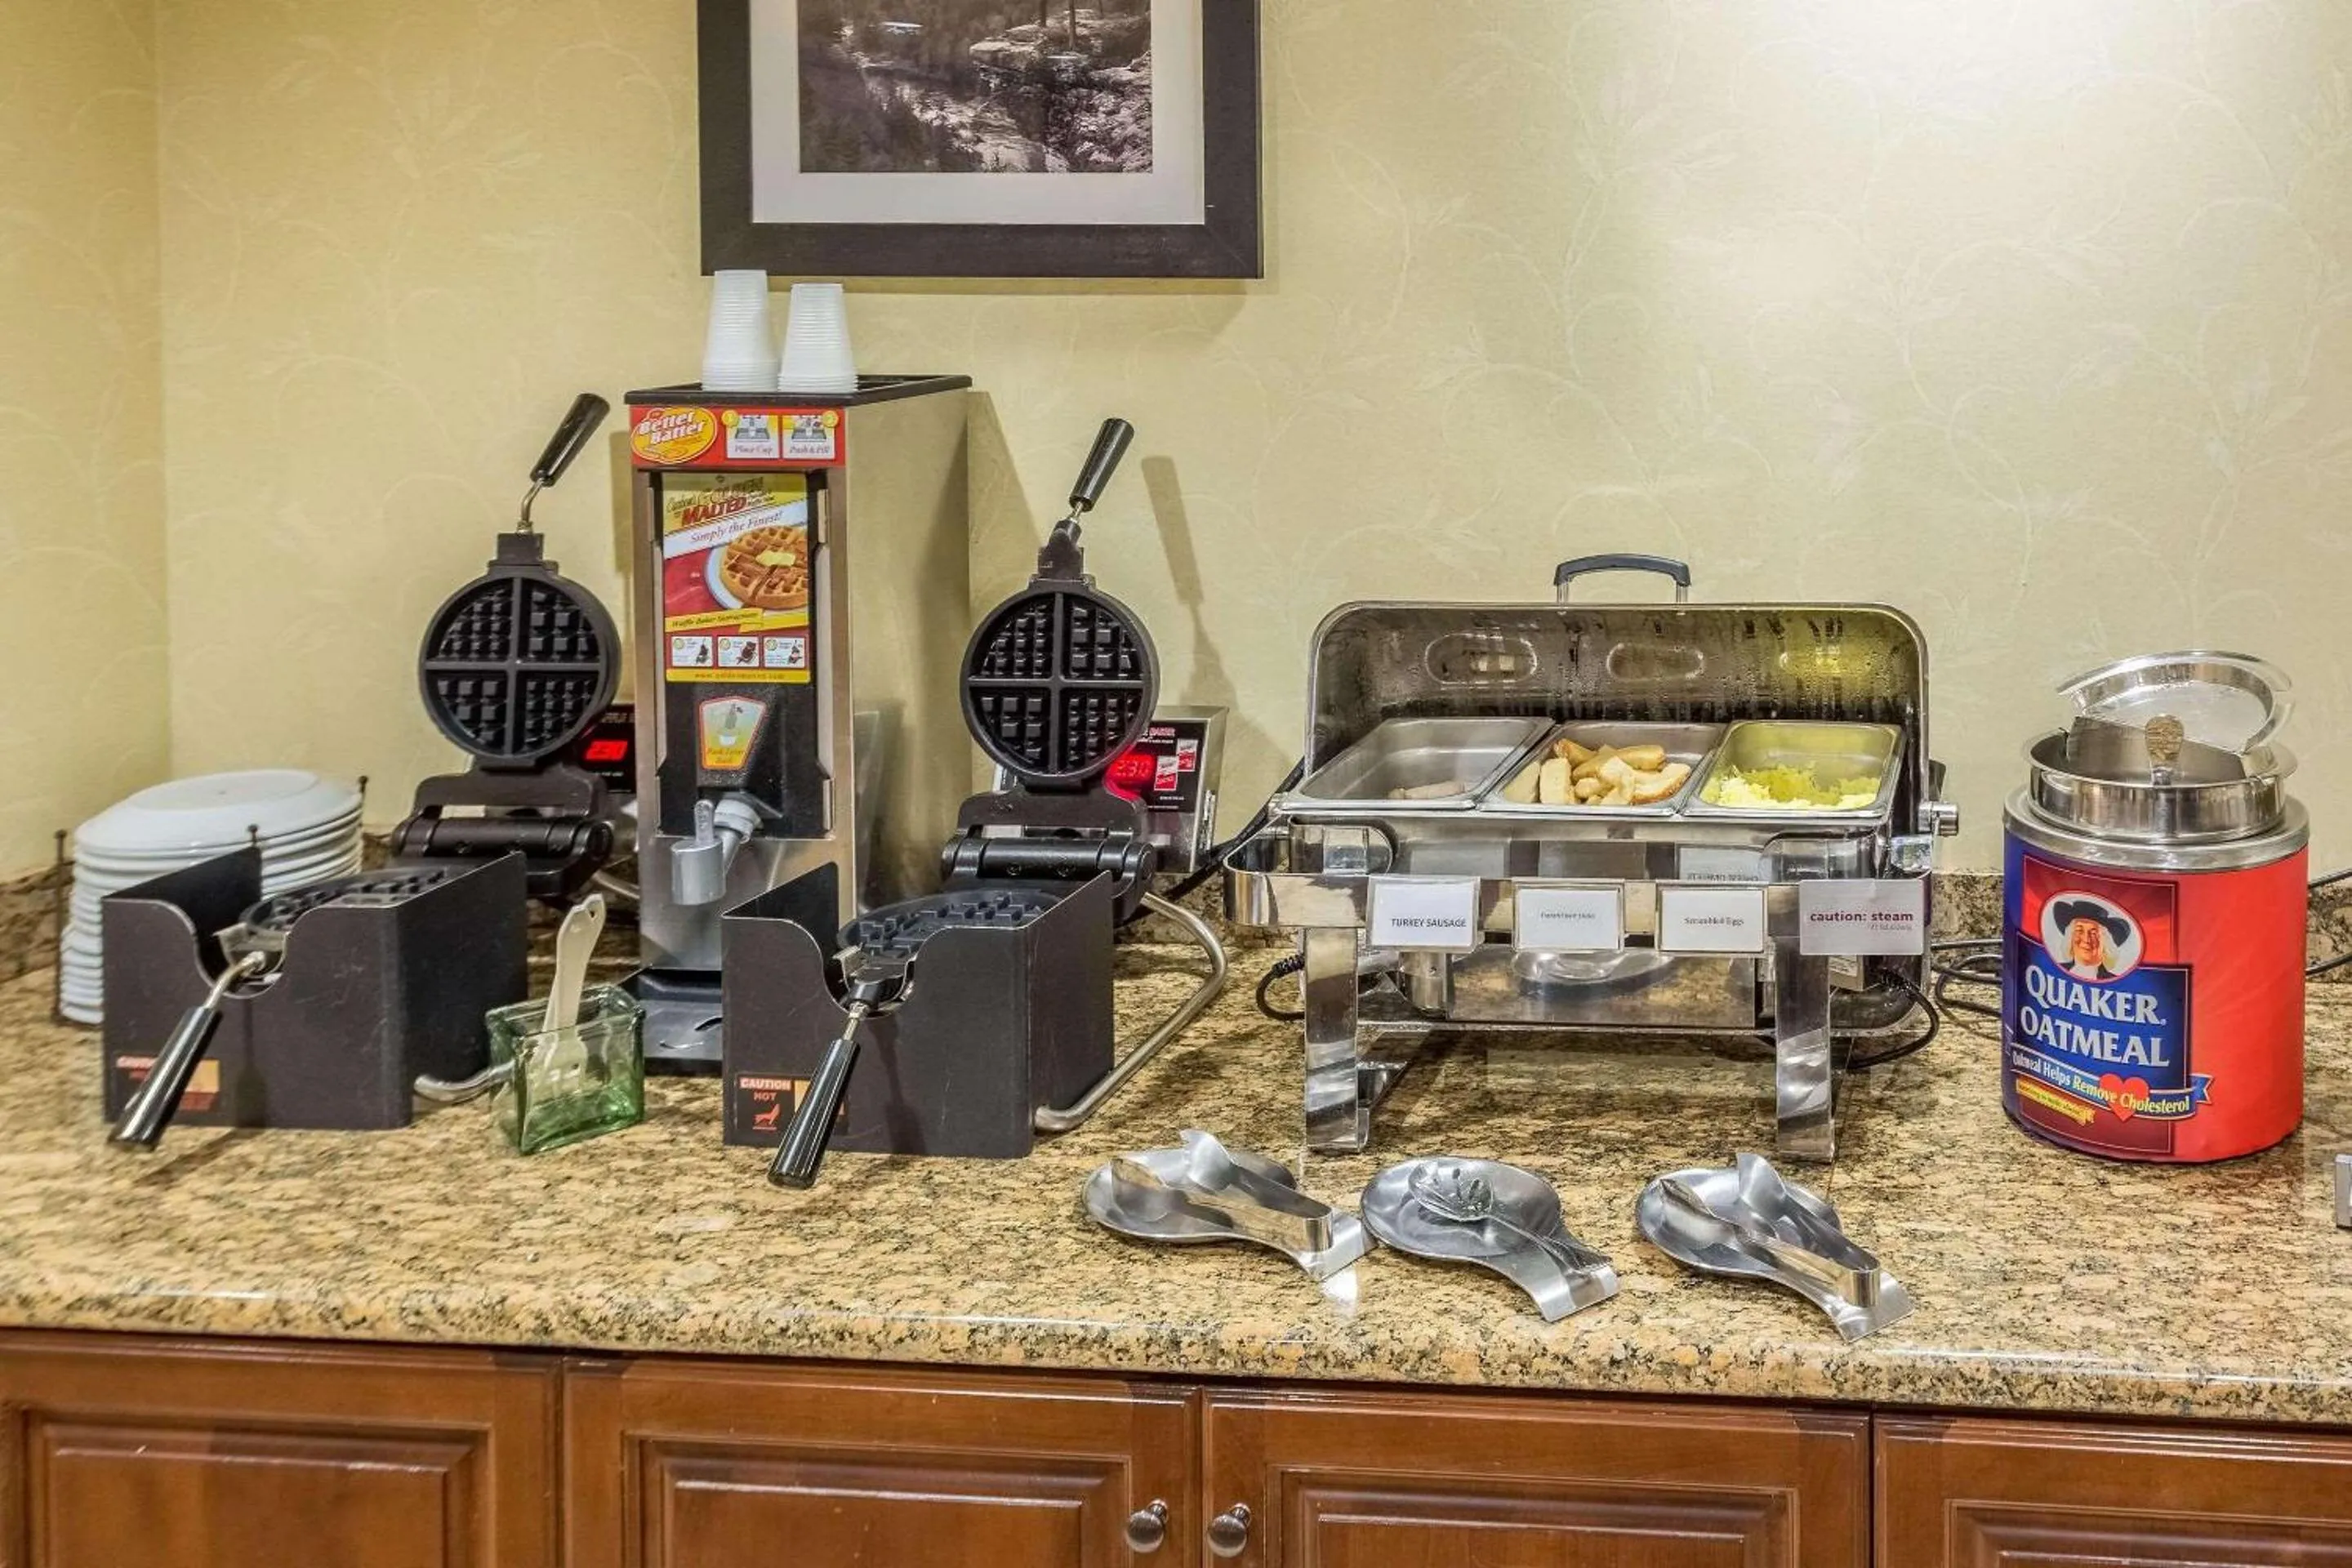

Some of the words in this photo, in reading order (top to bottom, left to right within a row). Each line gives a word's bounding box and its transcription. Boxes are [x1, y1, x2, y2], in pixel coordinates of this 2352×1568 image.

[681, 497, 747, 527] MALTED
[690, 525, 724, 543] Simply
[728, 521, 746, 535] the
[1391, 917, 1424, 929] TURKEY
[1425, 917, 1468, 929] SAUSAGE
[1810, 911, 1868, 922] caution:
[1870, 911, 1913, 922] steam
[2025, 964, 2159, 1025] QUAKER
[2020, 1005, 2170, 1067] OATMEAL
[739, 1077, 791, 1091] CAUTION
[2042, 1061, 2072, 1087] Helps
[2072, 1074, 2117, 1103] Remove
[2119, 1091, 2191, 1116] Cholesterol
[753, 1091, 777, 1102] HOT
